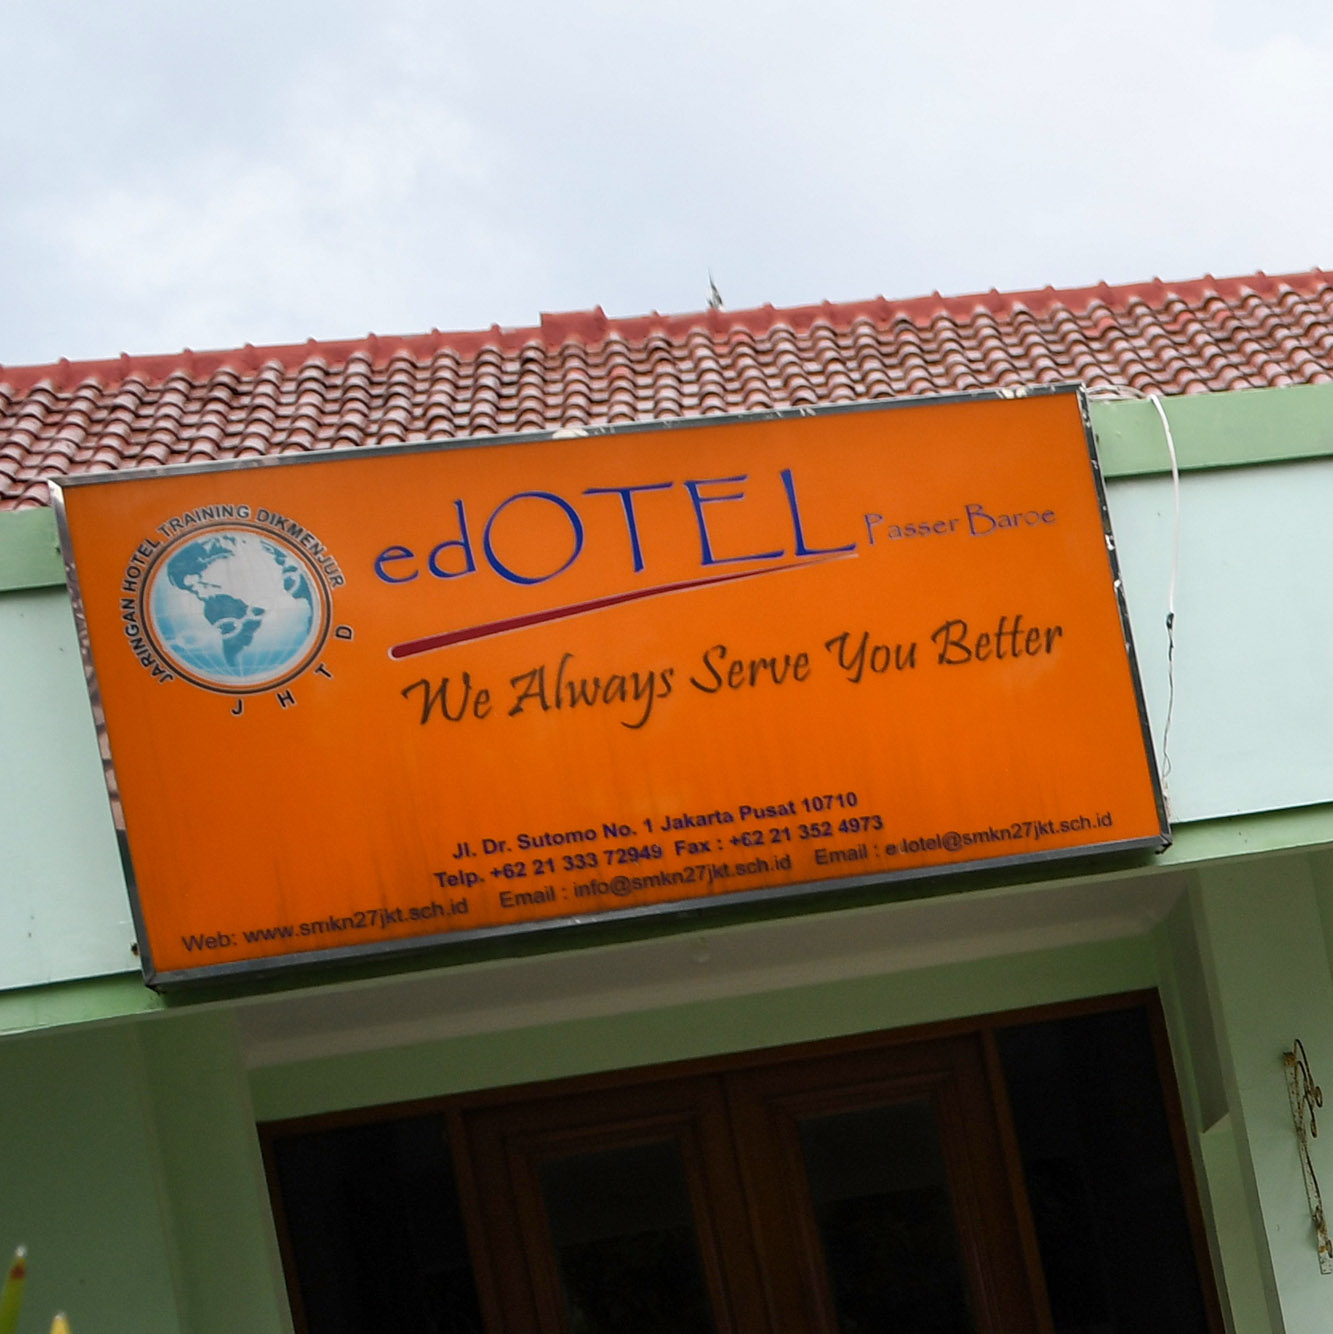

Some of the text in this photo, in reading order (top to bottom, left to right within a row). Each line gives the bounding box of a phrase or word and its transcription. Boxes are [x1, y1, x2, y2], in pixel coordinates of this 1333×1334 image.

[373, 468, 857, 585] edOTEL
[864, 503, 1056, 546] Passer Baroe
[121, 504, 347, 684] JARINGAN HOTEL TRAINING DIKMENJUR
[401, 614, 1063, 729] We Always Serve You Better
[433, 870, 485, 889] Telp.
[490, 862, 527, 880] +62
[532, 857, 555, 876] 21
[563, 852, 598, 872] 333
[604, 844, 663, 866] 72949
[674, 839, 710, 856] Fax
[729, 831, 765, 847] +62
[771, 827, 791, 843] 21
[799, 821, 833, 840] 352
[838, 815, 883, 833] 4973
[452, 791, 858, 860] Jl. Dr. Sutomo No. 1 Jakarta Pusat 10710
[181, 933, 238, 952] Web:
[242, 898, 469, 944] www.smkn27jkt.sch.id
[499, 885, 555, 909] Email
[573, 854, 792, 898] info@smkn27jkt.sch.id
[814, 844, 868, 866] Email
